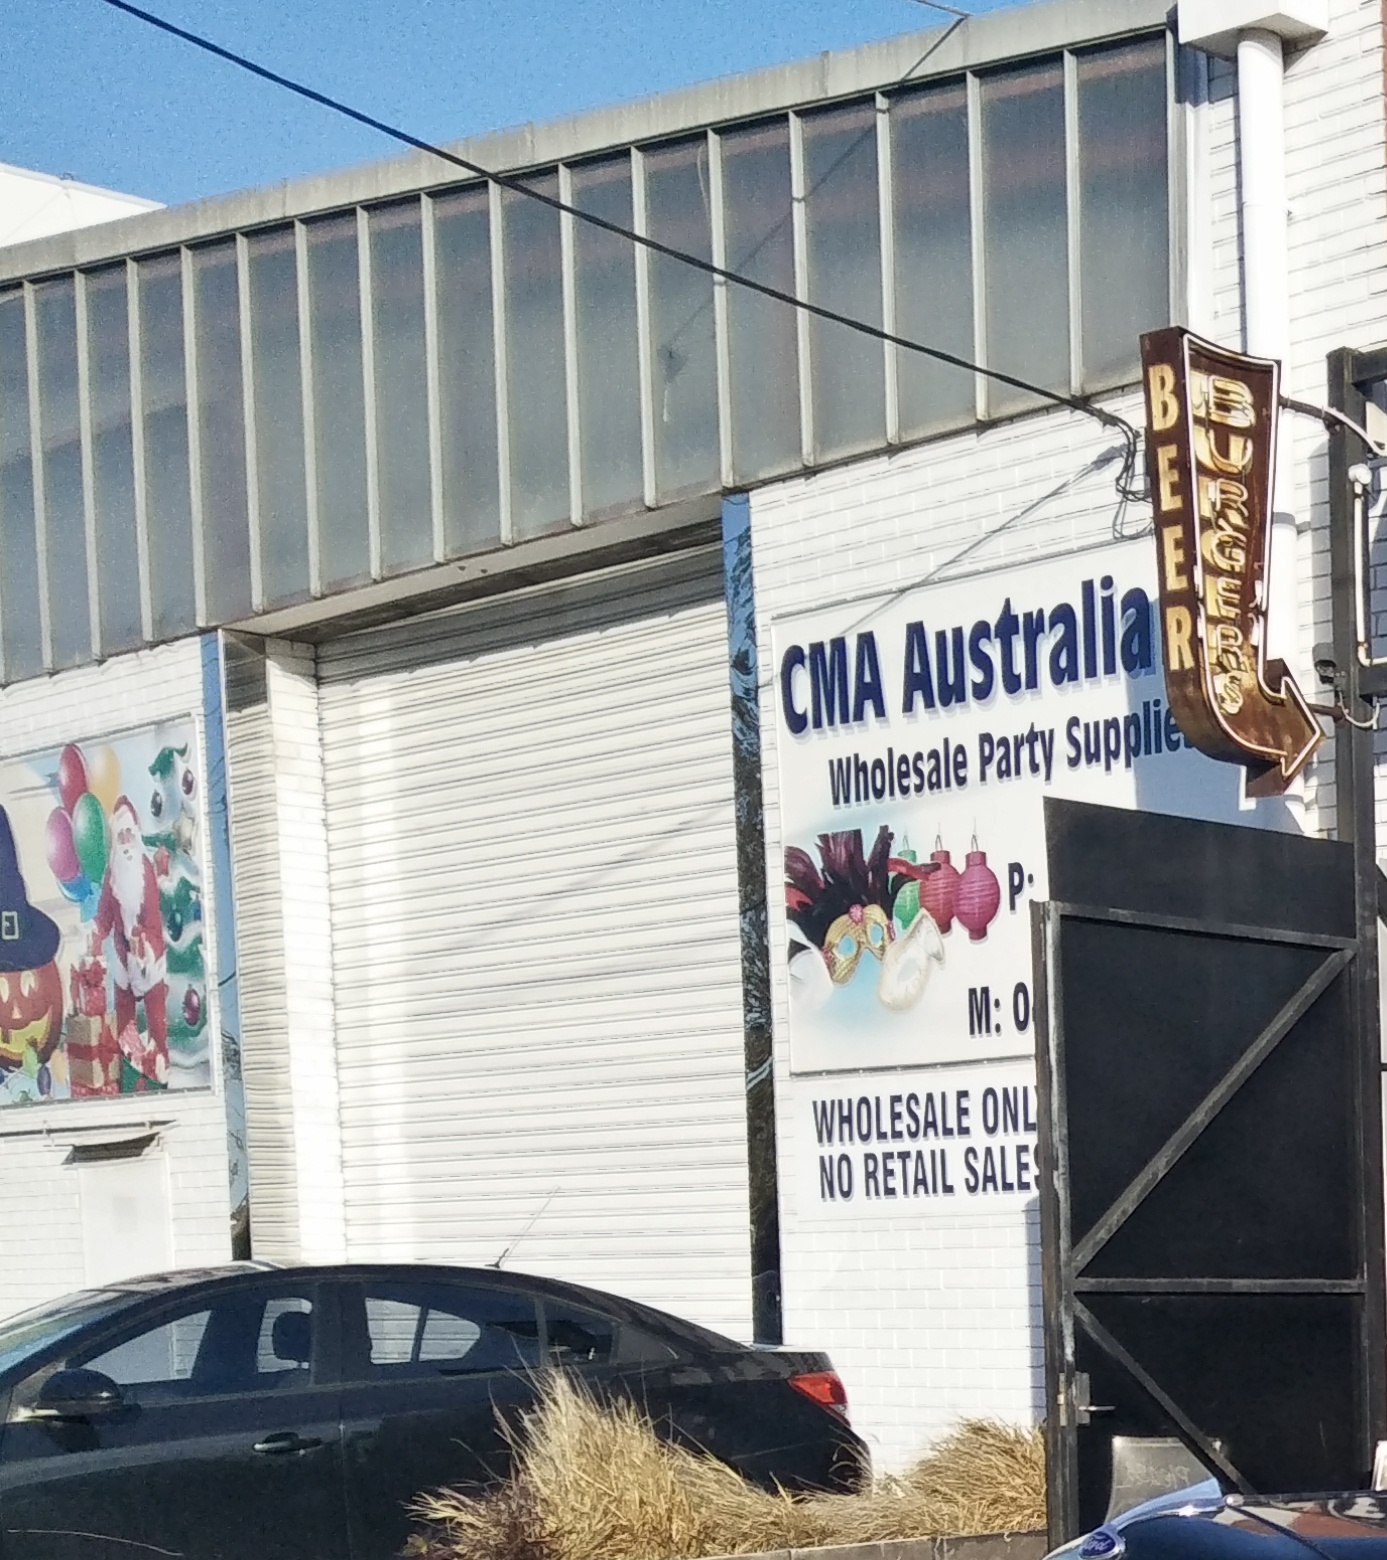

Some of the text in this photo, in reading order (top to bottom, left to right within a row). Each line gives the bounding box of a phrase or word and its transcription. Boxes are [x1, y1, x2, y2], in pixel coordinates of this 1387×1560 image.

[1148, 363, 1196, 671] BEER
[1190, 371, 1256, 716] BURGERS
[781, 574, 1151, 736] CMA Australia
[829, 698, 1193, 806] Wholesale Party Supplie
[968, 986, 1001, 1036] M:
[813, 1086, 1037, 1144] WHOLESALE ONL
[819, 1152, 855, 1200] NO
[864, 1147, 956, 1197] RETAIL
